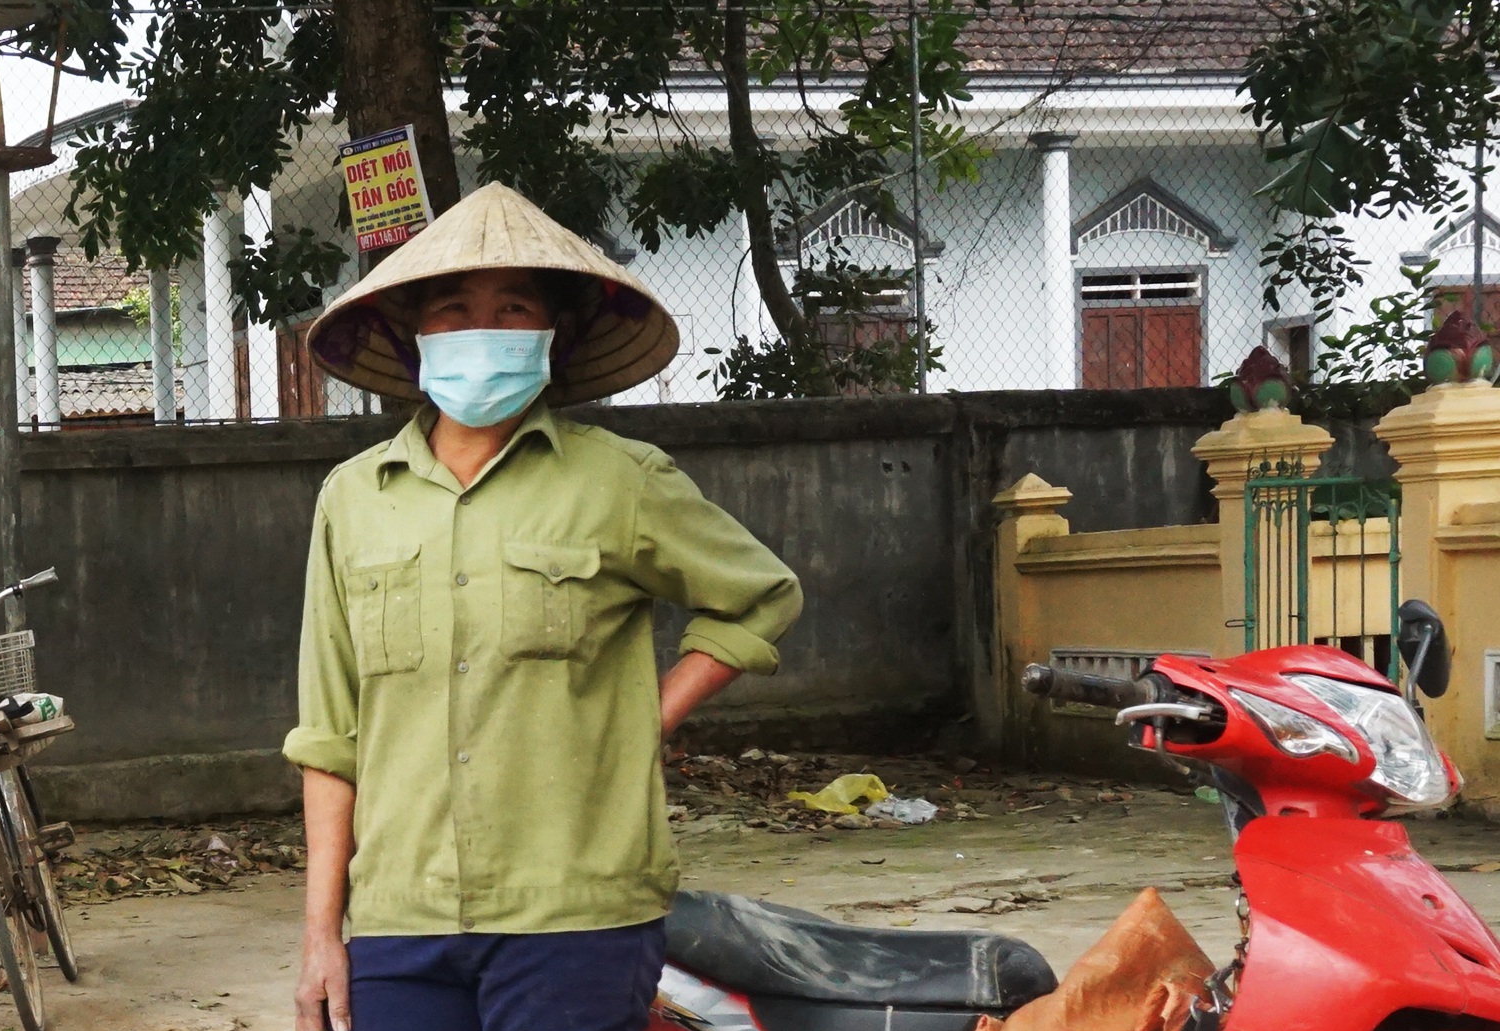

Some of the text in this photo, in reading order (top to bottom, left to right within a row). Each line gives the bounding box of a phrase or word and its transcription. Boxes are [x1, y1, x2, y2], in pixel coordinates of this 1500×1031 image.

[346, 145, 413, 184] DIỆT MỐI
[352, 173, 418, 212] TẬN GỐC
[361, 227, 407, 249] 0971.146.171
